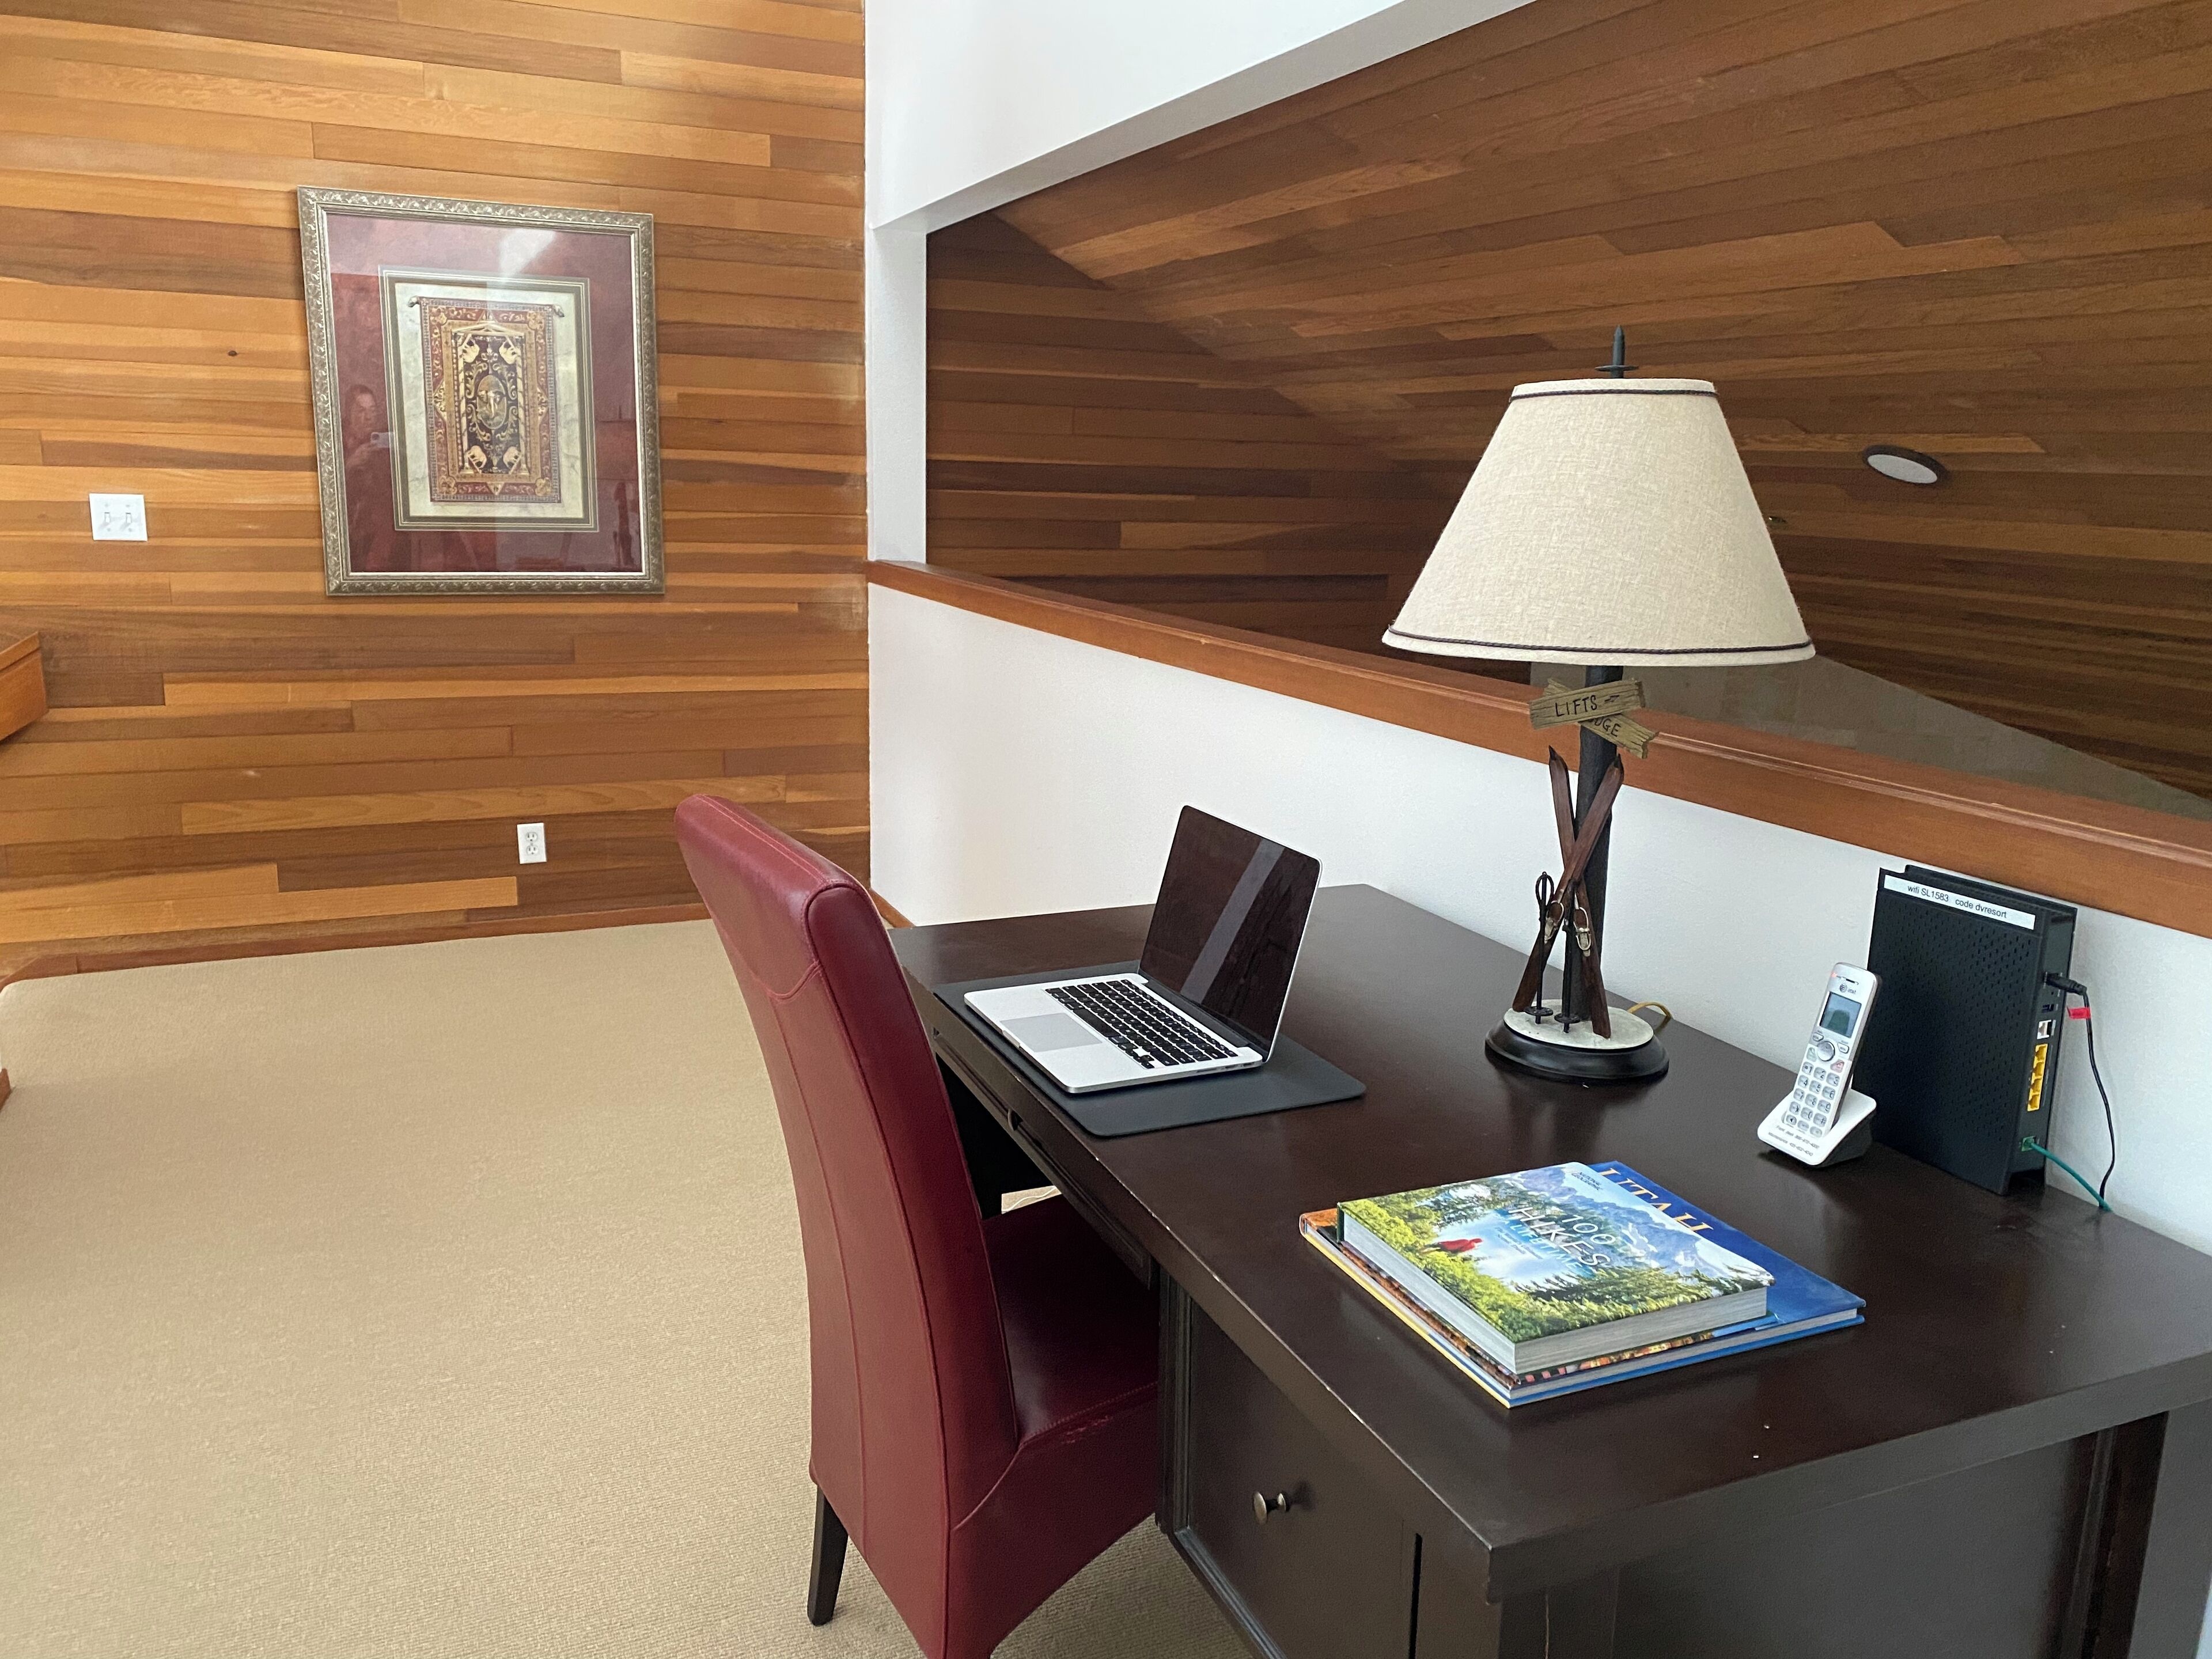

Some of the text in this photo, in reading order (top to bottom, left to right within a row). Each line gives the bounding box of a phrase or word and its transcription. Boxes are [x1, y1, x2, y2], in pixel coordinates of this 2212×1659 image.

[1555, 695, 1598, 717] LIFTS
[1907, 885, 2008, 918] wifi SL1583 code dvresort
[1599, 1168, 1714, 1232] UTAH
[1508, 1207, 1611, 1266] HIKES
[1509, 1224, 1584, 1269] LIFETIME
[1562, 1214, 1616, 1244] 100
